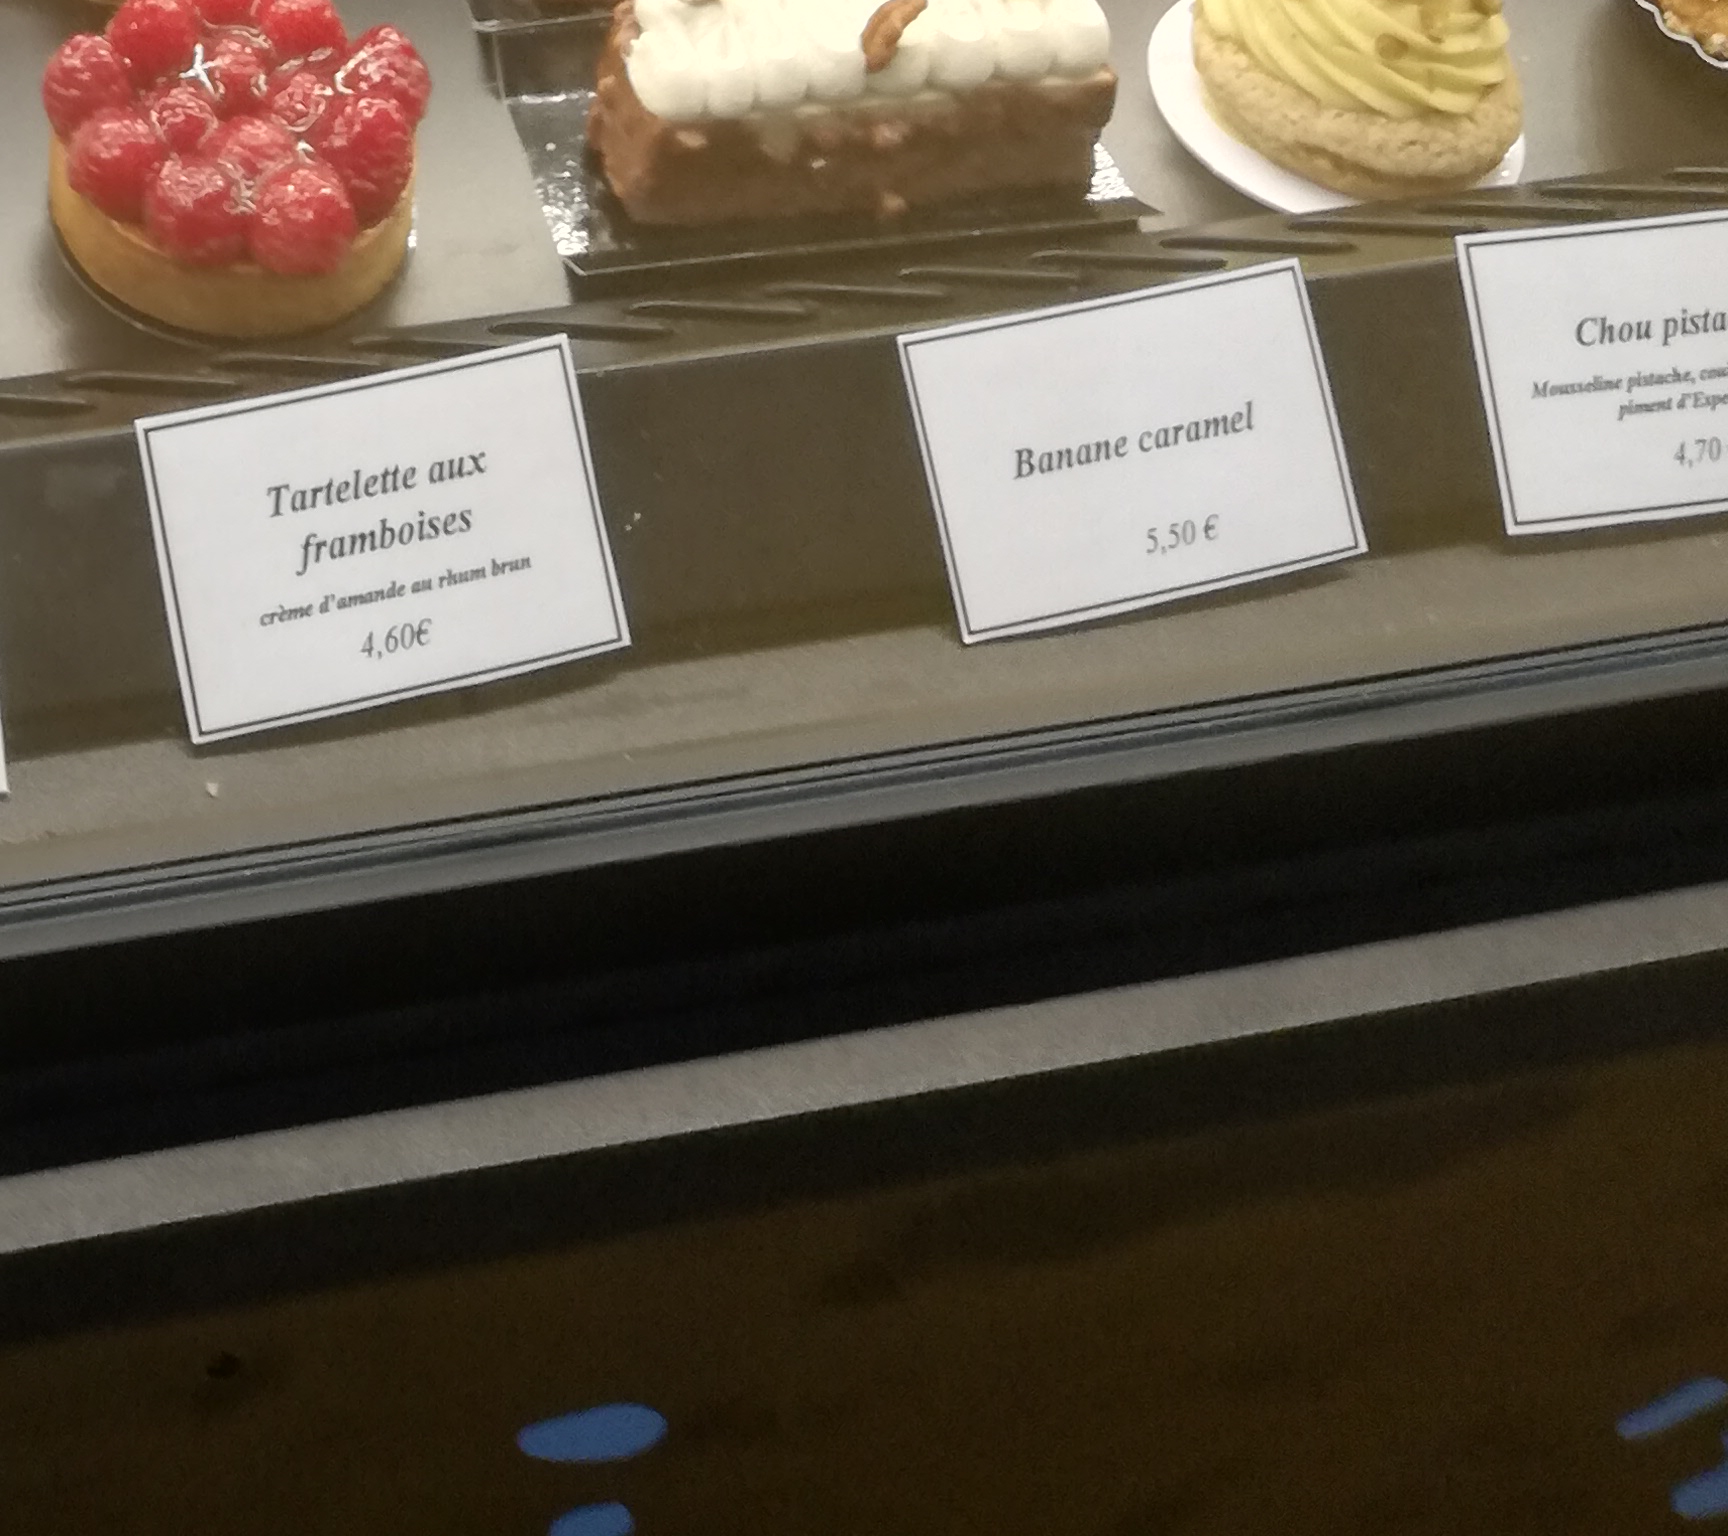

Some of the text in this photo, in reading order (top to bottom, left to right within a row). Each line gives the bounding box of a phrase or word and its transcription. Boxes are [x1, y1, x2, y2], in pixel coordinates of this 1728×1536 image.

[1575, 307, 1727, 347] Chou pista
[1012, 401, 1255, 480] Banane caramel
[267, 449, 487, 518] Tartelette aux
[296, 508, 473, 576] framboises
[259, 554, 532, 628] crème d'amande au rhum brun
[360, 618, 433, 660] 4,60€
